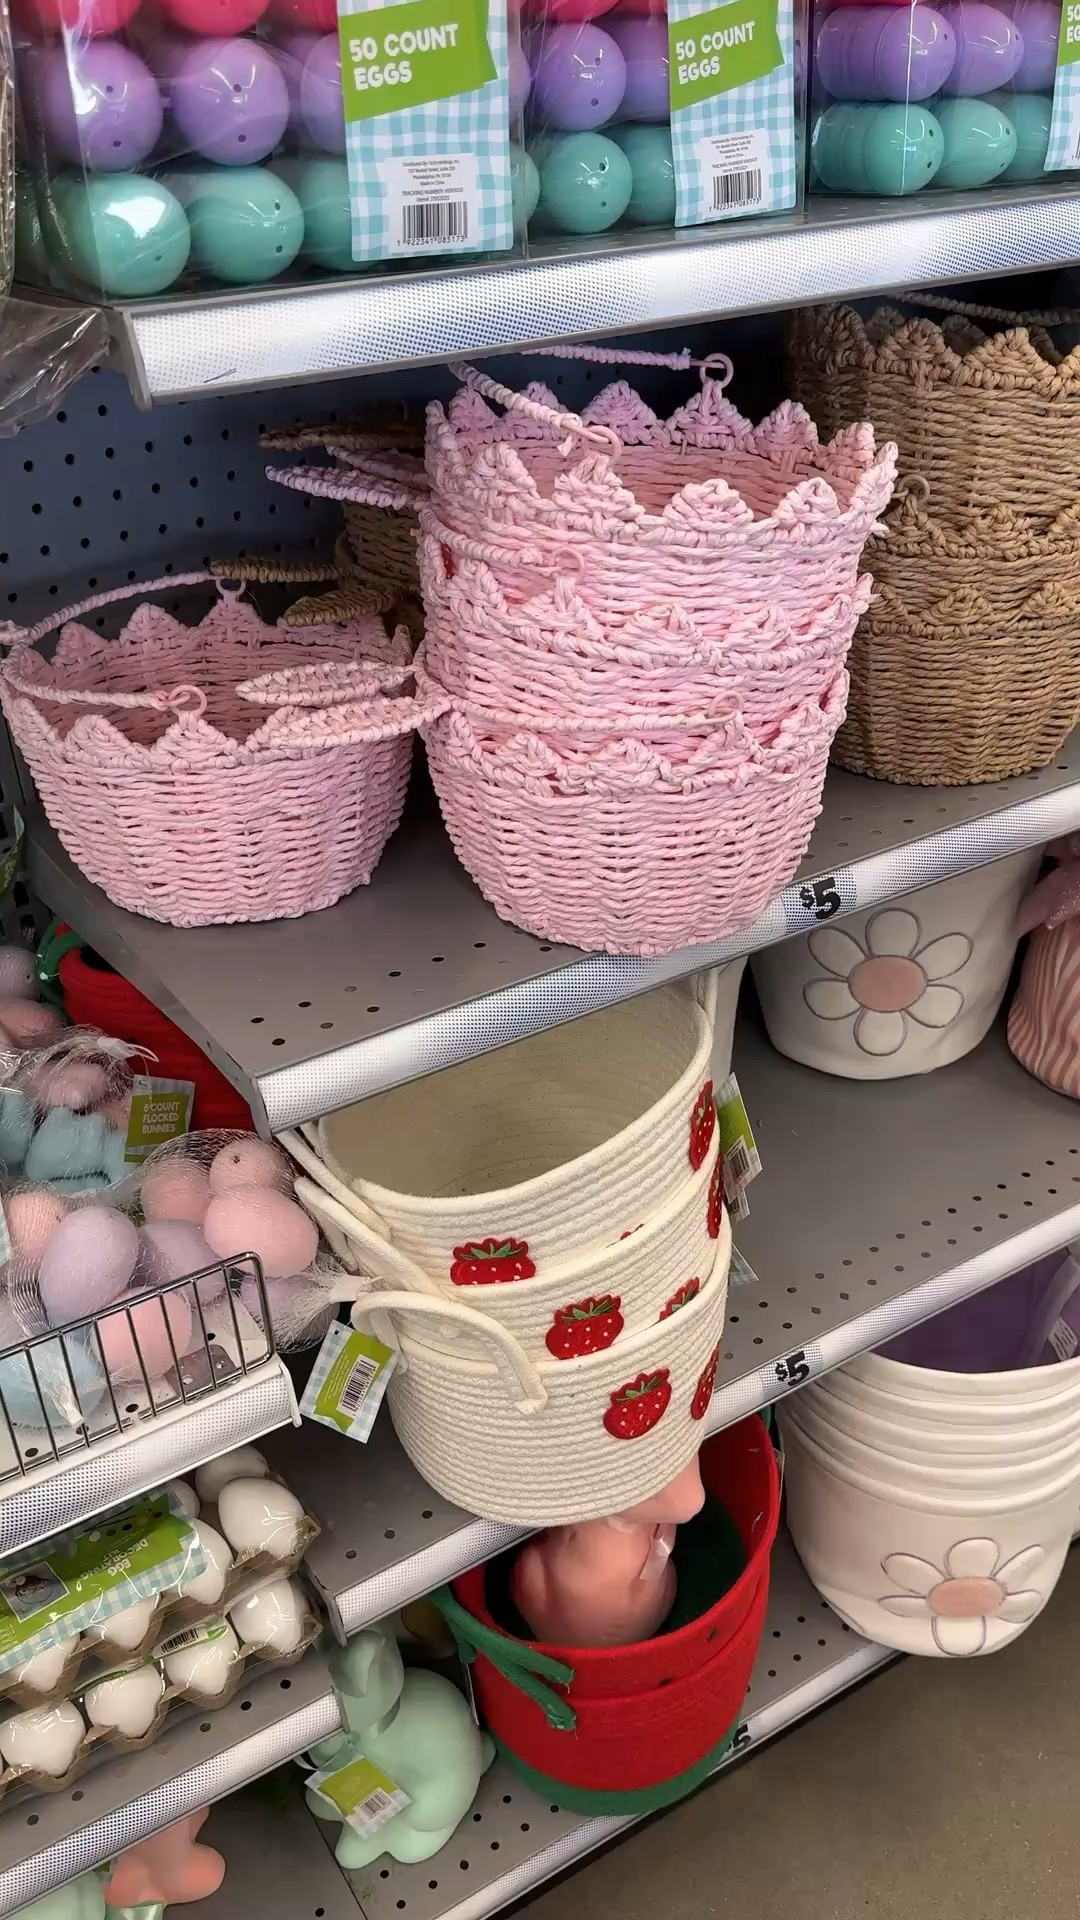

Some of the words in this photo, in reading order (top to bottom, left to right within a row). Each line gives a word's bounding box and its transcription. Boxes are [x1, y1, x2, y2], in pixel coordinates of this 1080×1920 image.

[349, 37, 378, 63] 50
[384, 23, 459, 57] COUNT
[675, 39, 696, 61] 50
[700, 20, 756, 54] COUNT
[353, 60, 412, 91] EGGS
[677, 56, 721, 85] EGGS
[800, 877, 841, 919] $5
[143, 1113, 179, 1123] FLOCKED
[150, 1102, 180, 1112] COUNT
[142, 1123, 176, 1134] BUNNIES
[775, 1350, 810, 1386] $5
[80, 1538, 149, 1580] DECORATING
[108, 1558, 131, 1576] EGG
[728, 1723, 752, 1756] 5
